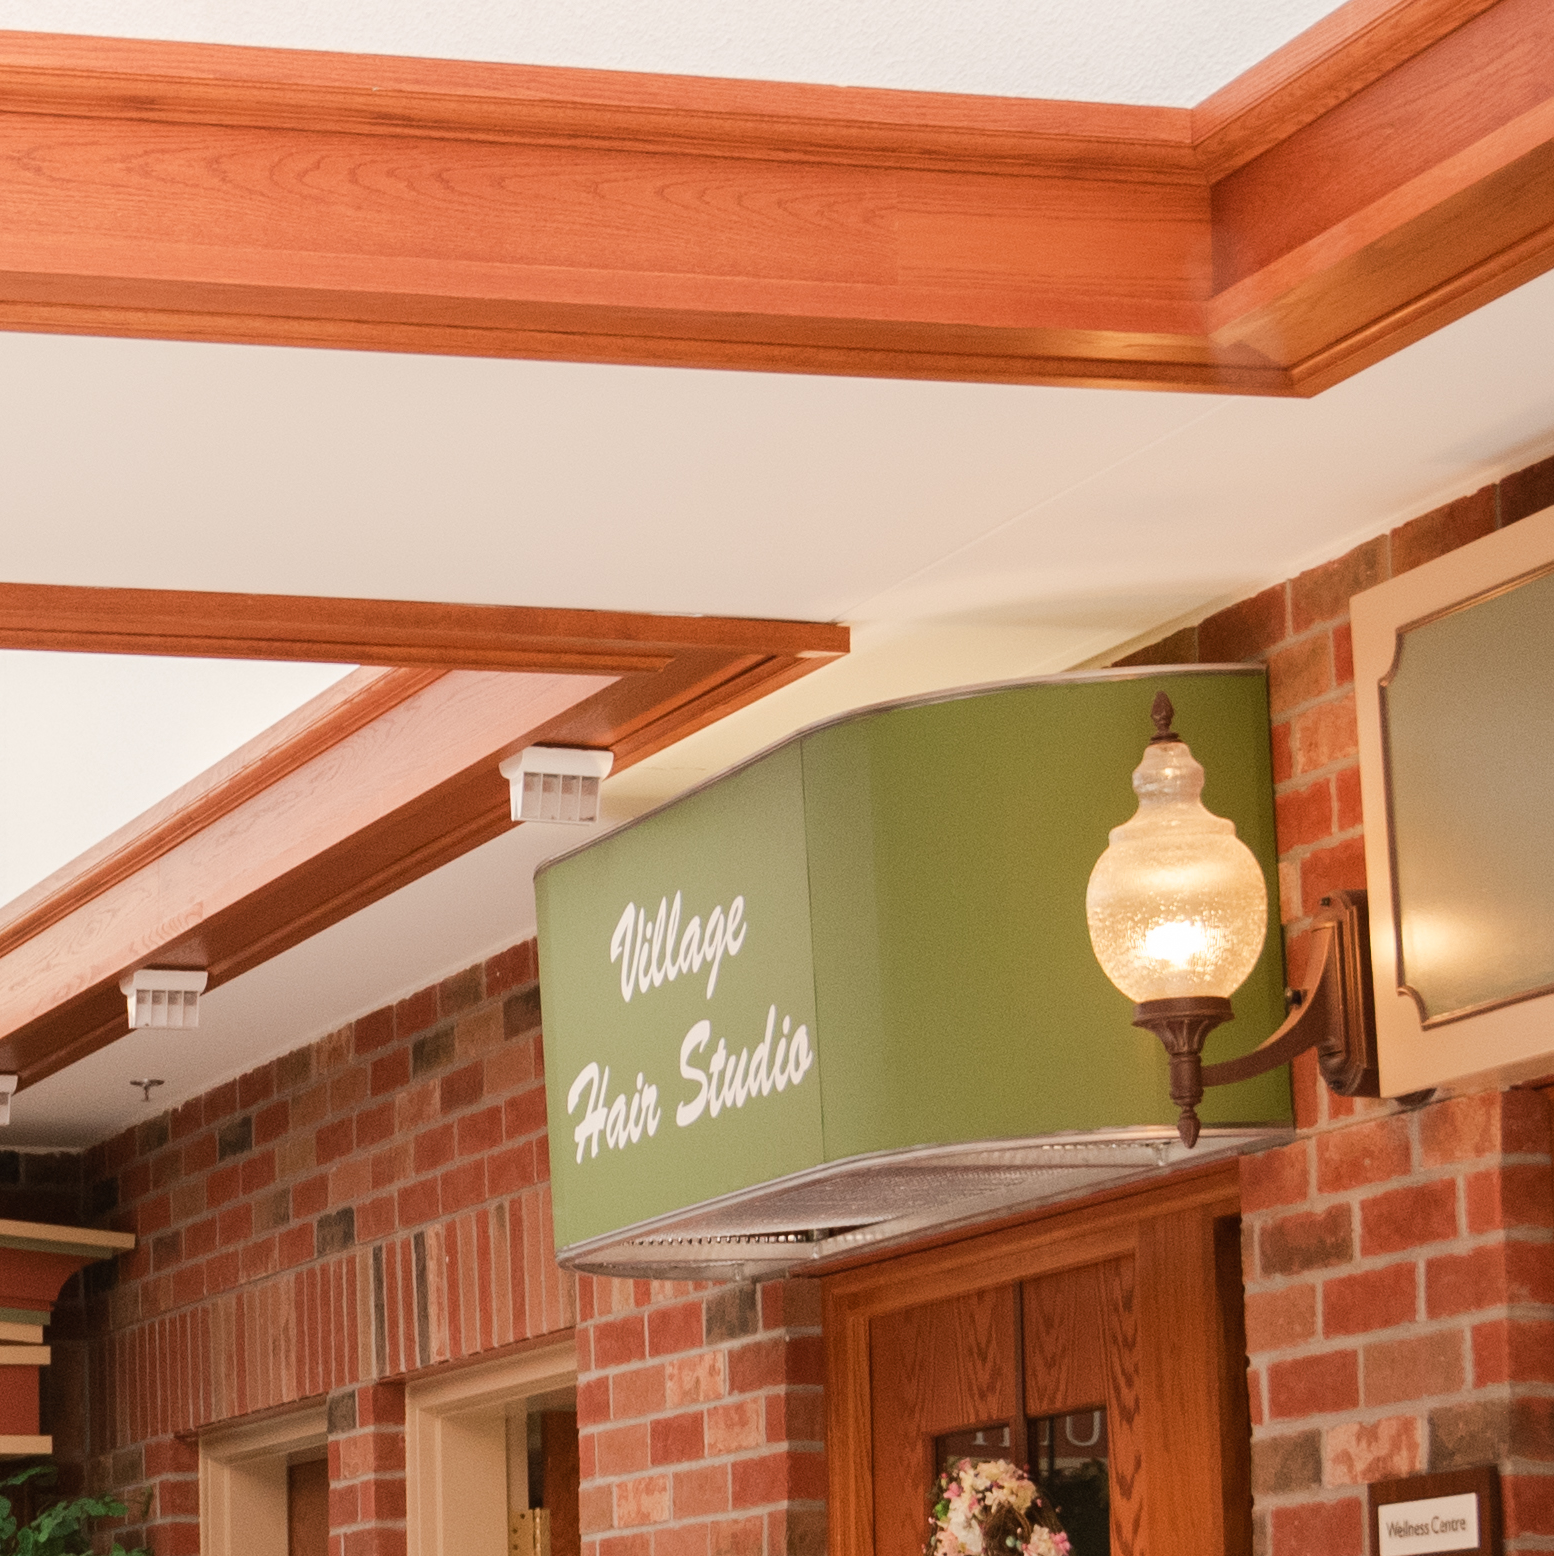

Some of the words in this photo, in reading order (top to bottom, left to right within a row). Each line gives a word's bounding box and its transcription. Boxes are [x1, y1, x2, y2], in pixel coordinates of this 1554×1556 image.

[609, 890, 747, 1003] Village
[567, 1061, 662, 1165] Hair
[676, 1003, 815, 1128] Studio
[1385, 1520, 1429, 1538] Wellness
[1430, 1515, 1467, 1535] Centre
